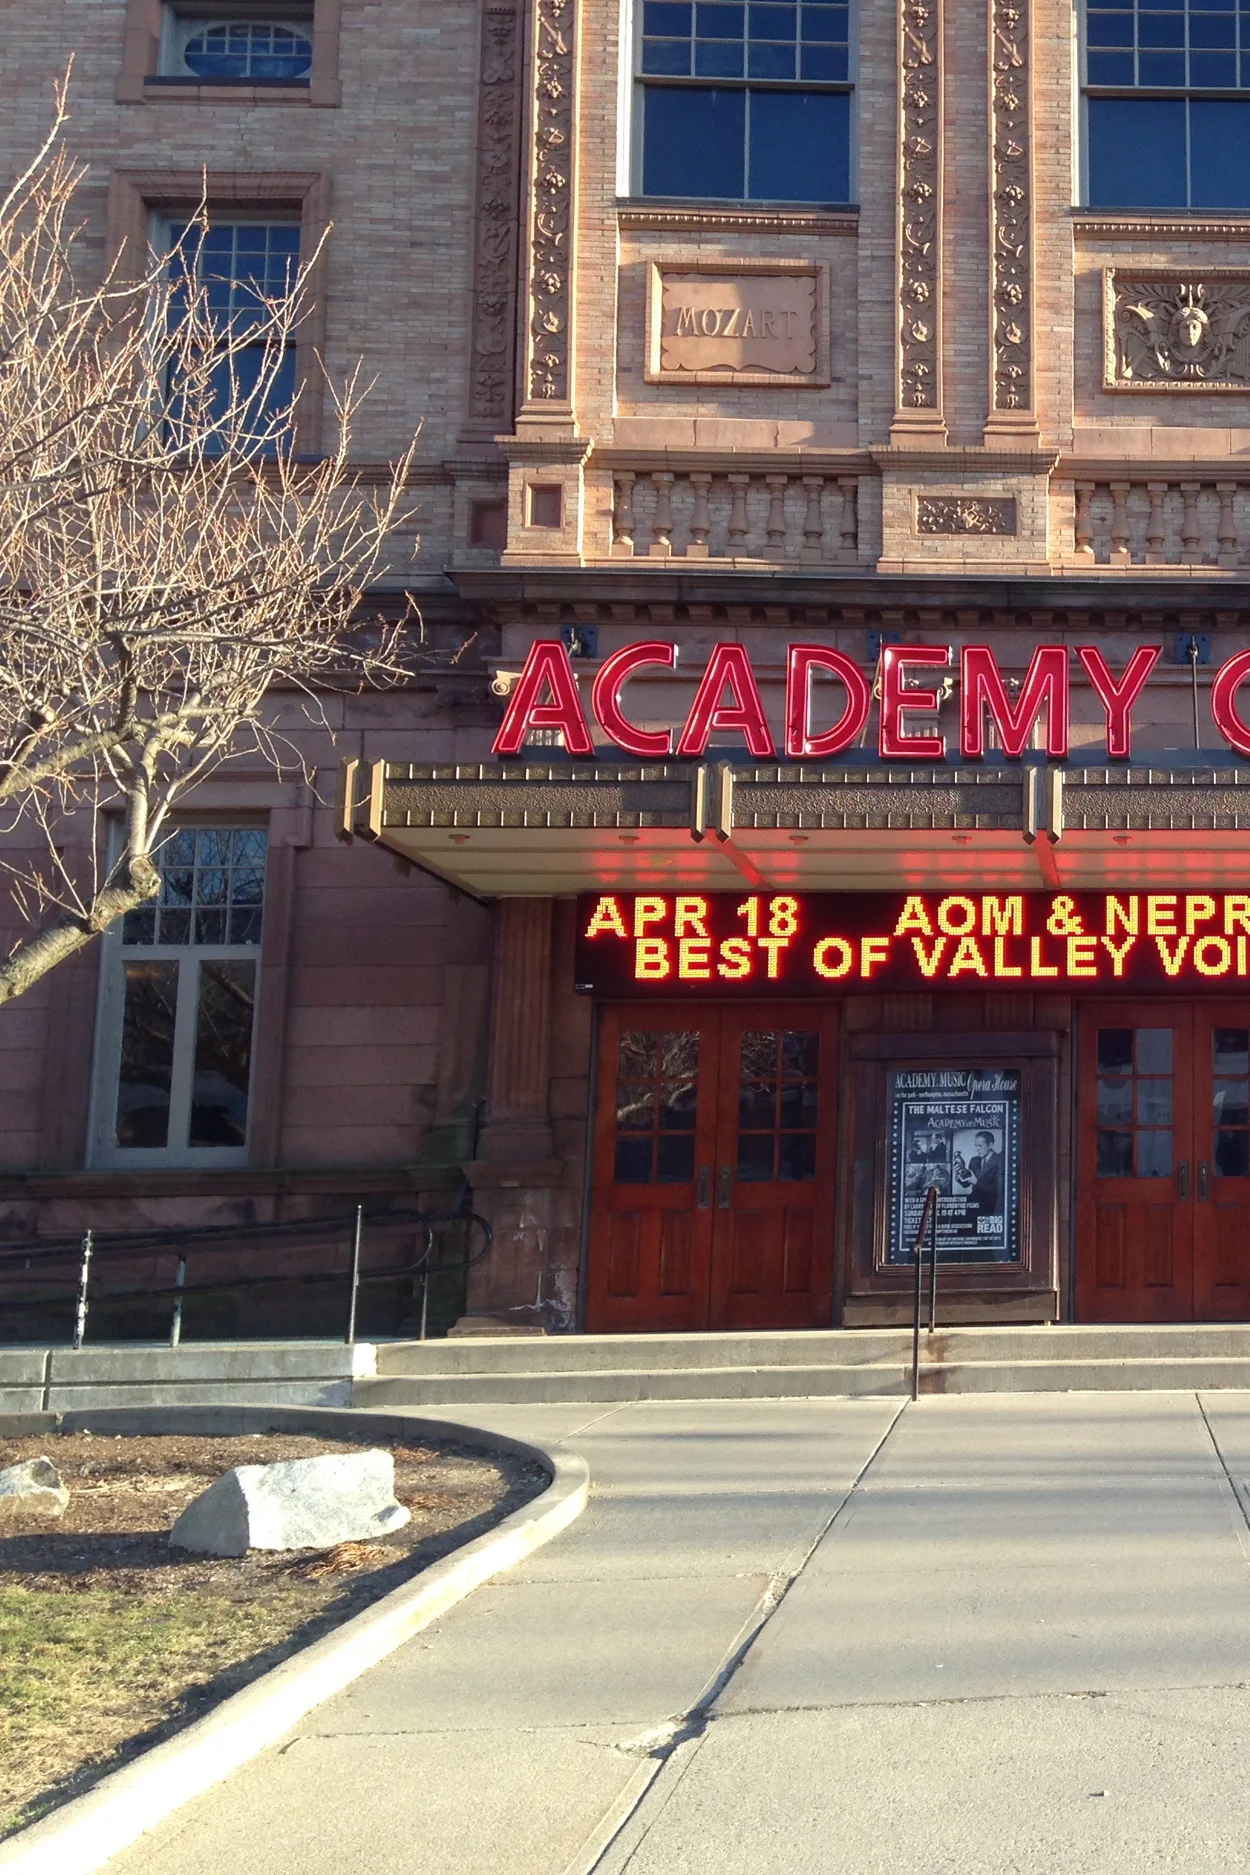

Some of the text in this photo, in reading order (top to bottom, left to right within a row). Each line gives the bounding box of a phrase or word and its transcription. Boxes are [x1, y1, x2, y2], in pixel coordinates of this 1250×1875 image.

[674, 307, 798, 339] MOZART
[490, 639, 1164, 760] ACADEMY
[585, 895, 708, 938] APR
[736, 896, 799, 937] 18
[893, 895, 1023, 936] AOM
[1046, 895, 1084, 935] &
[634, 936, 790, 979] BEST
[812, 937, 890, 978] OF
[910, 936, 1136, 977] VALLEY
[895, 1070, 1018, 1100] ACADEMY MUSIC Opera House
[908, 1104, 1004, 1114] THE MALTESE FALCON
[927, 1117, 965, 1128] ACADEMY
[973, 1115, 1001, 1128] MUSIC
[977, 1224, 1003, 1234] READ
[990, 1216, 1003, 1224] BIG
